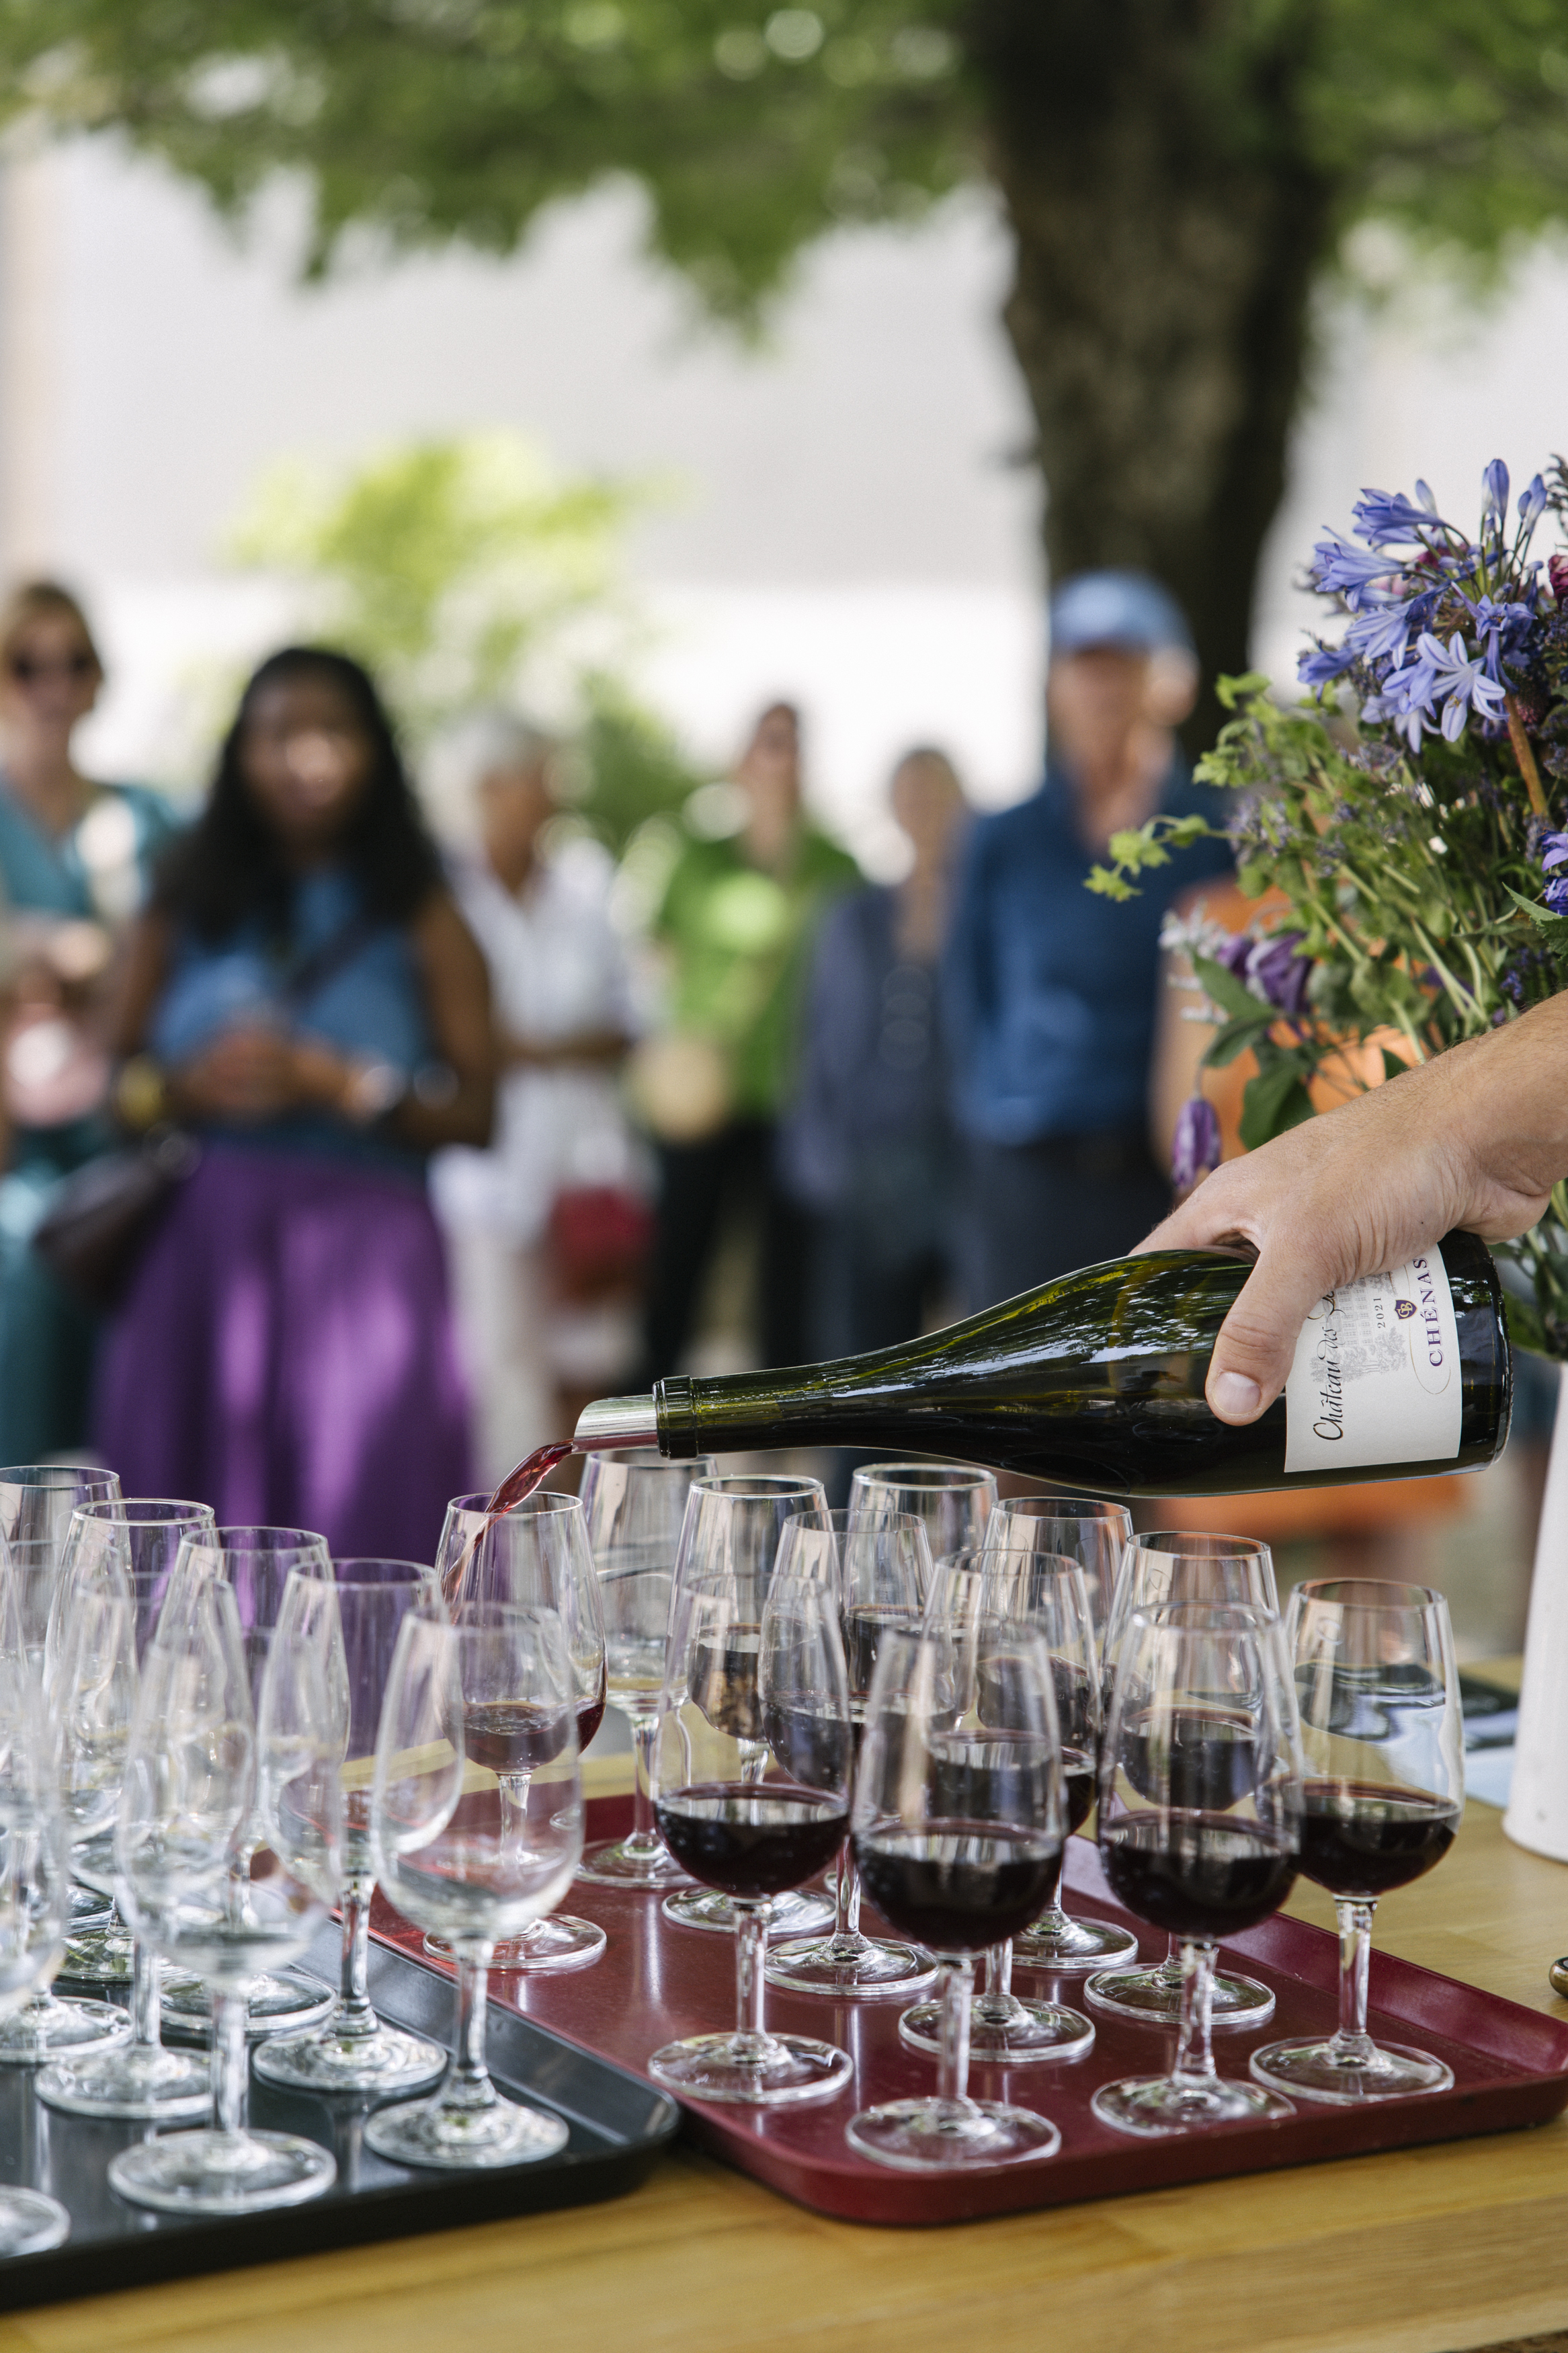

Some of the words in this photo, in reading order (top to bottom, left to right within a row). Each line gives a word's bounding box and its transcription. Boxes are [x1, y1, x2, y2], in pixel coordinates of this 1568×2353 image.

[1373, 1296, 1386, 1328] 2021
[1413, 1257, 1444, 1367] CHÉNAS
[1317, 1326, 1339, 1359] des
[1313, 1360, 1344, 1441] Château
